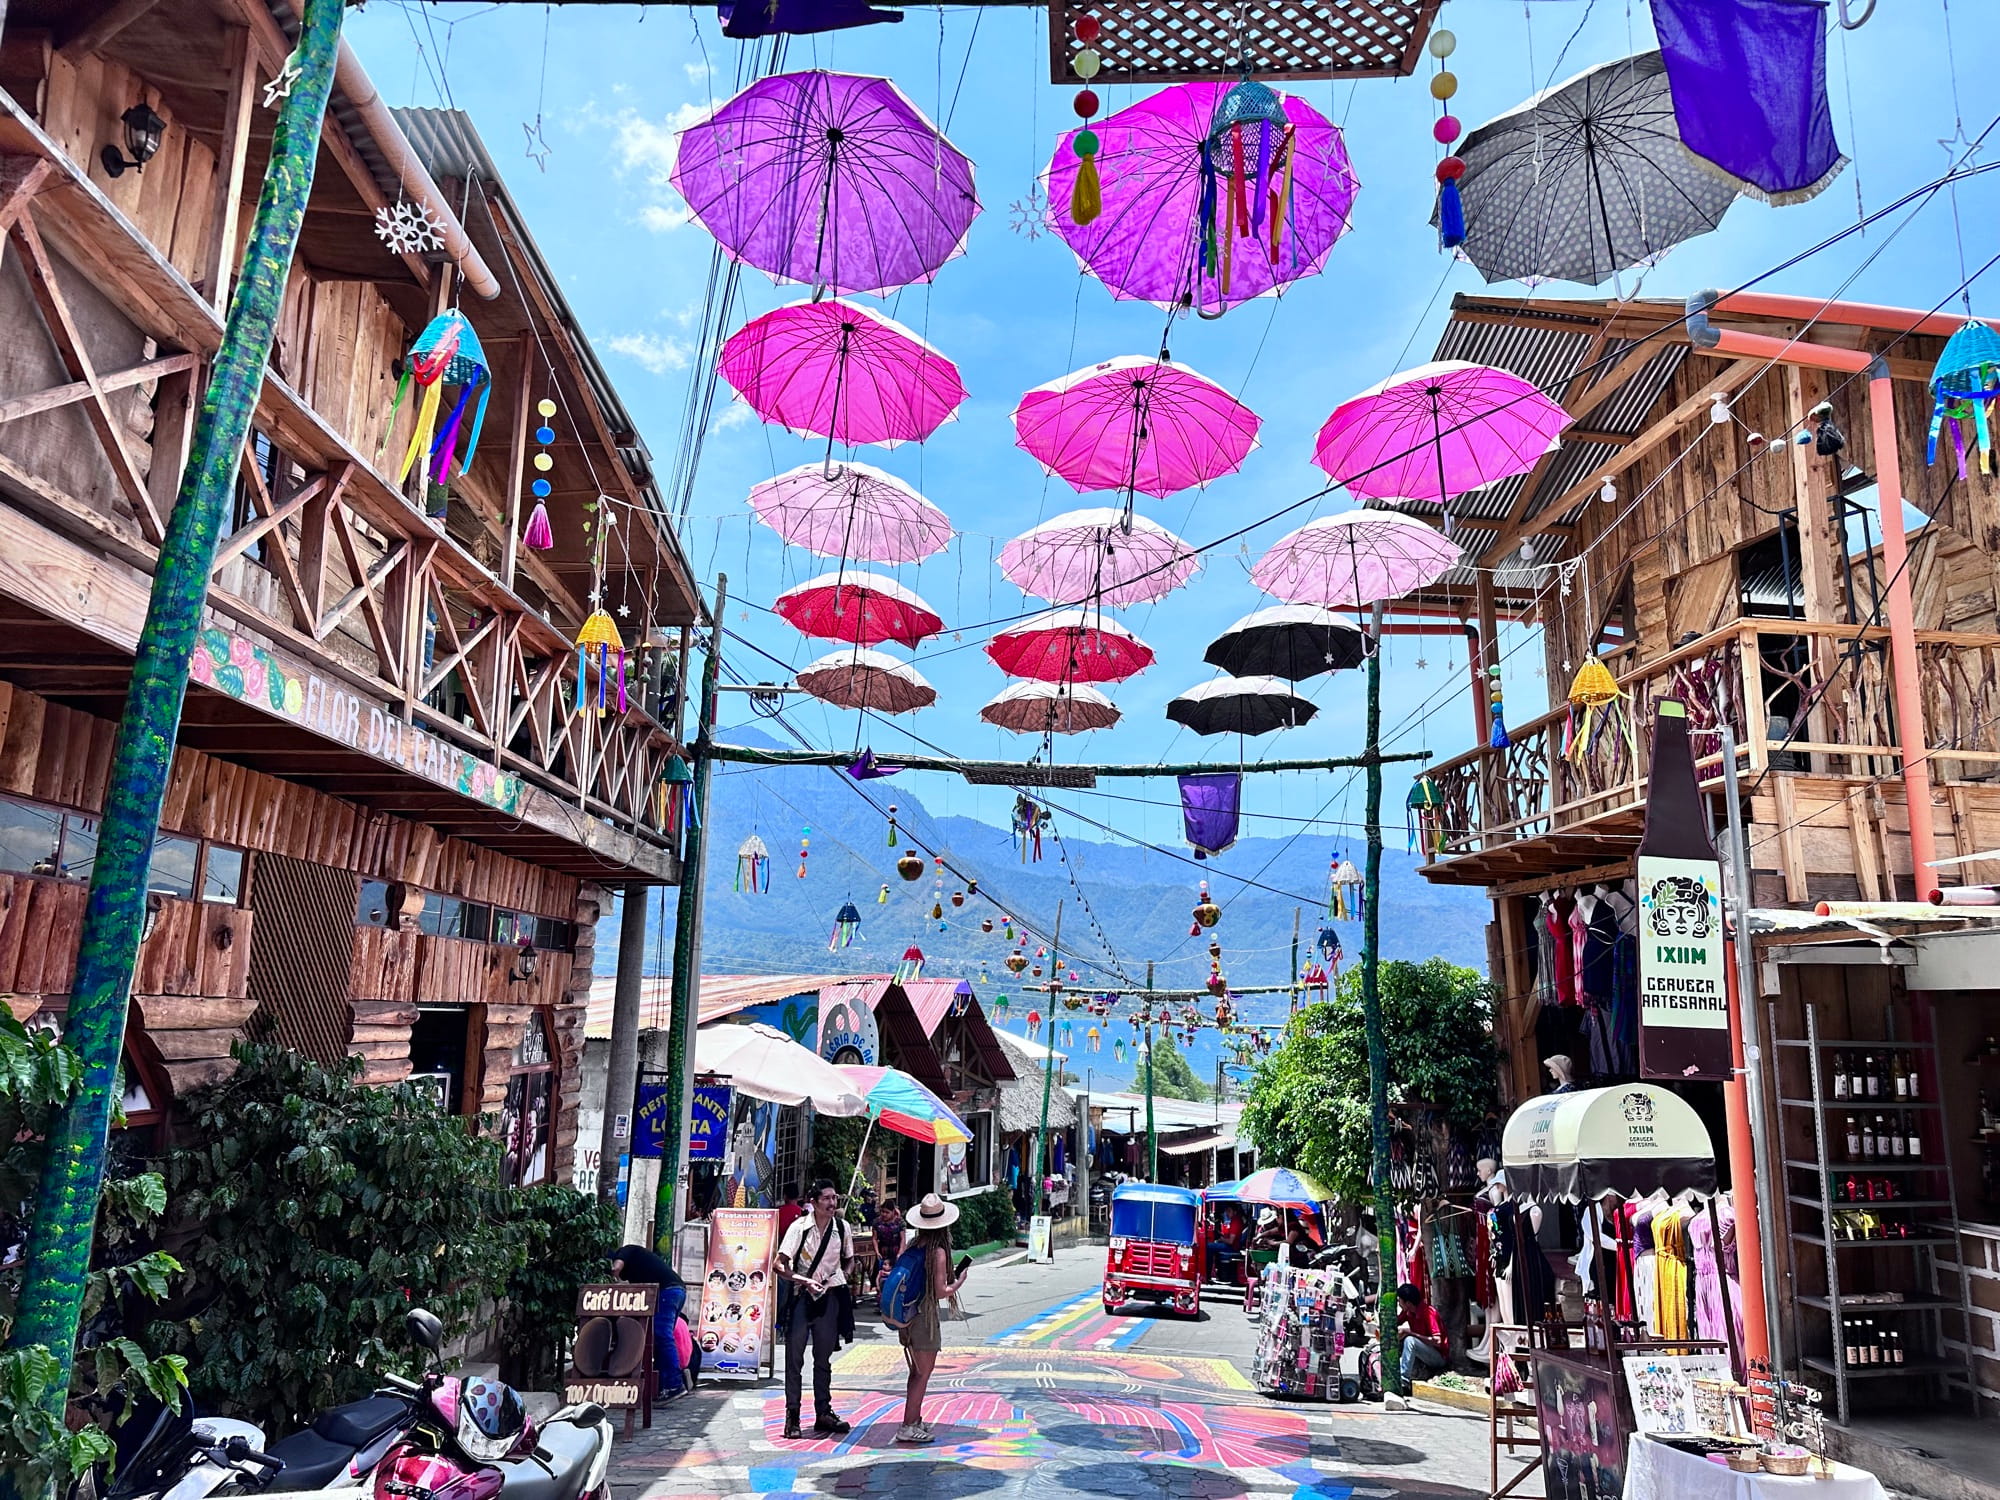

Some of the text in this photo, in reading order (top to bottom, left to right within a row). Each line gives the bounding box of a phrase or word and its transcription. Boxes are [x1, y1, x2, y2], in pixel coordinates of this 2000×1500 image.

[305, 674, 360, 748] FLOR
[368, 707, 406, 766] DEL
[1647, 976, 1715, 994] CERVEZA
[1642, 994, 1728, 1011] ARTESANAL
[852, 1033, 866, 1049] DE
[639, 1092, 727, 1122] RESTANTE
[651, 1118, 712, 1135] LTA
[582, 1287, 650, 1312] Café Local
